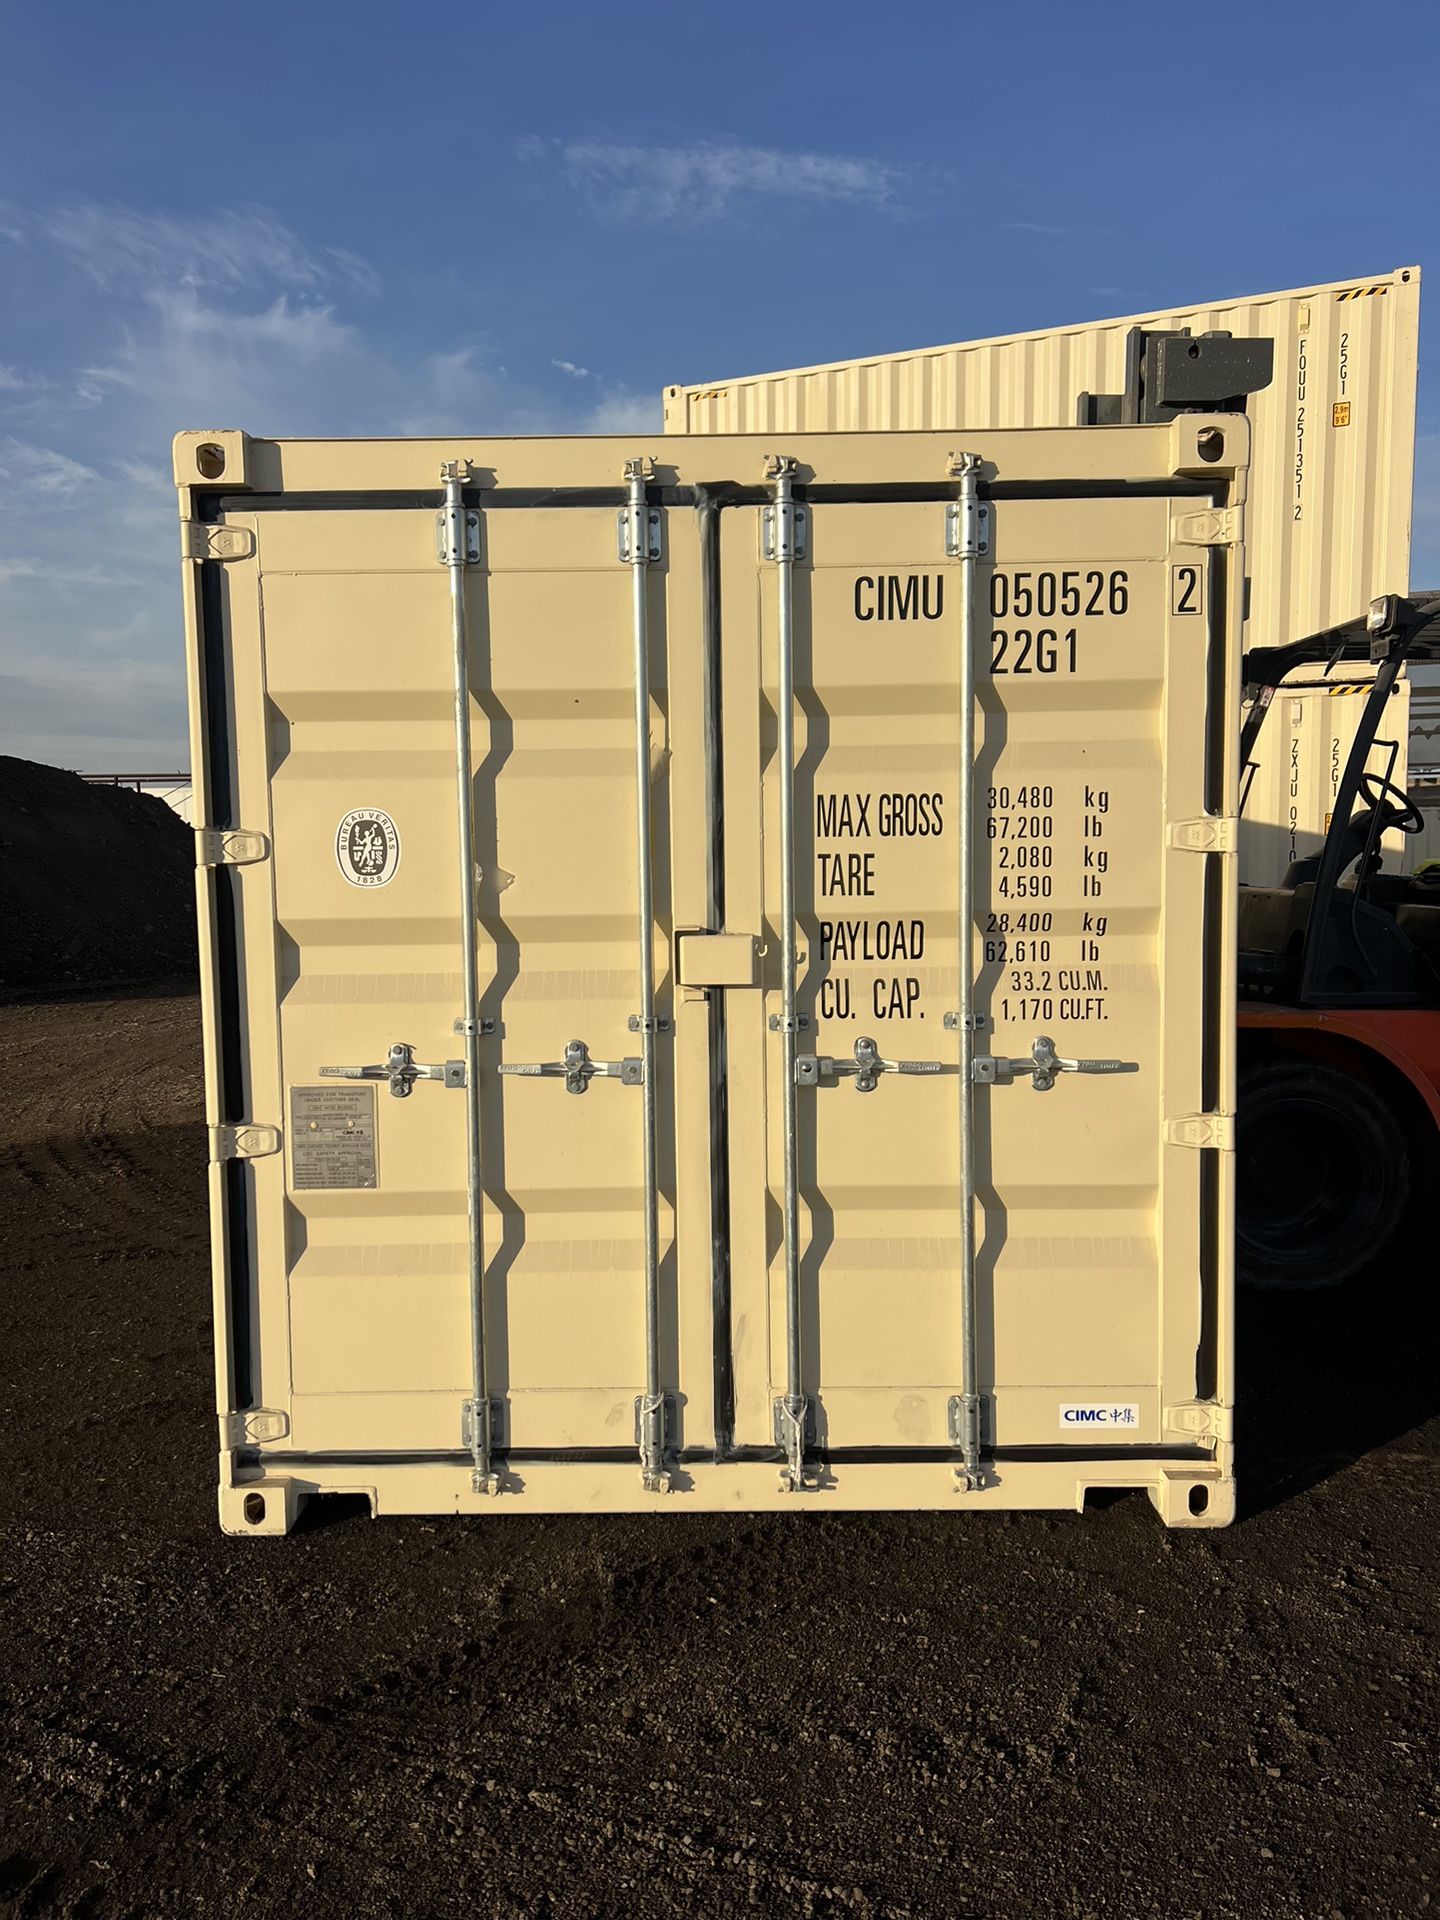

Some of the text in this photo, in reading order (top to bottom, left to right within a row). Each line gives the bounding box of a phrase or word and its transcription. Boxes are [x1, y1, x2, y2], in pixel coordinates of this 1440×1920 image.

[1339, 333, 1349, 395] 25G1
[1294, 339, 1307, 520] FOUU 251351 2
[854, 567, 1198, 621] CIMU 050526 2
[989, 628, 1077, 675] 22G1
[1291, 739, 1299, 797] ZXJU
[1331, 738, 1340, 796] 25G1
[817, 793, 943, 837] MAX GROSS
[987, 785, 1109, 813] 30,480 kg
[341, 812, 396, 850] BUREAU VERITAS
[987, 815, 1102, 840] 67,200 lb
[817, 853, 875, 896] TARE
[999, 845, 1108, 873] 2,080 kg
[356, 875, 382, 884] 1828
[999, 875, 1102, 899] 4,590 lb
[820, 920, 924, 960] PAYLOAD
[986, 912, 1108, 937] 28,400 kg
[985, 939, 1100, 964] 62,610 lb
[821, 977, 925, 1019] CU. CAP.
[1011, 970, 1108, 991] 33.2 CU.M.
[1002, 998, 1109, 1022] 1,170 CU.FT.
[1064, 1409, 1107, 1421] CIMC
